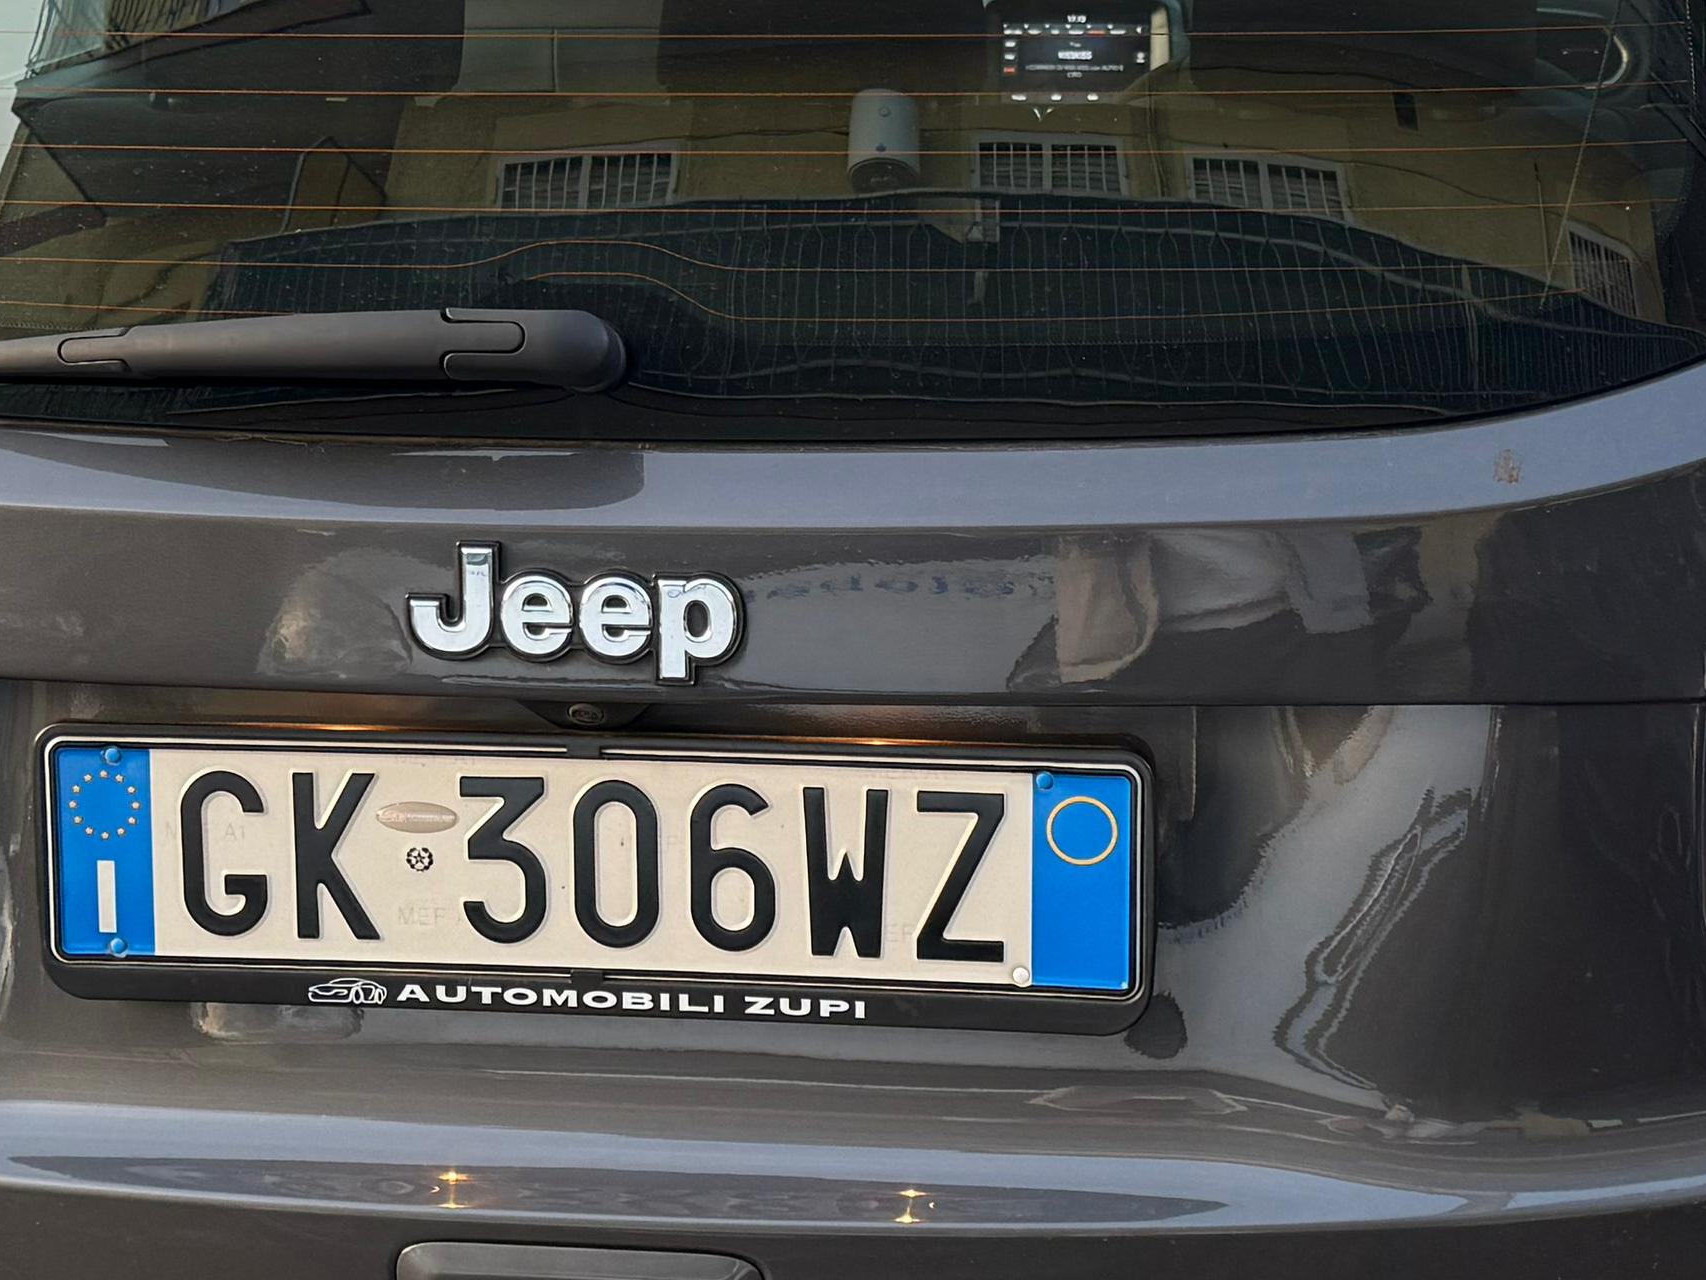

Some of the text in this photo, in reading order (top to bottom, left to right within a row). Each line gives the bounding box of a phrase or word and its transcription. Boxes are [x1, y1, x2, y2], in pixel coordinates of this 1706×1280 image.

[405, 540, 747, 686] Jeep
[178, 769, 382, 942] GK
[457, 774, 1008, 966] 306WZ
[396, 983, 867, 1020] AUTOMOBILI ZUPI
